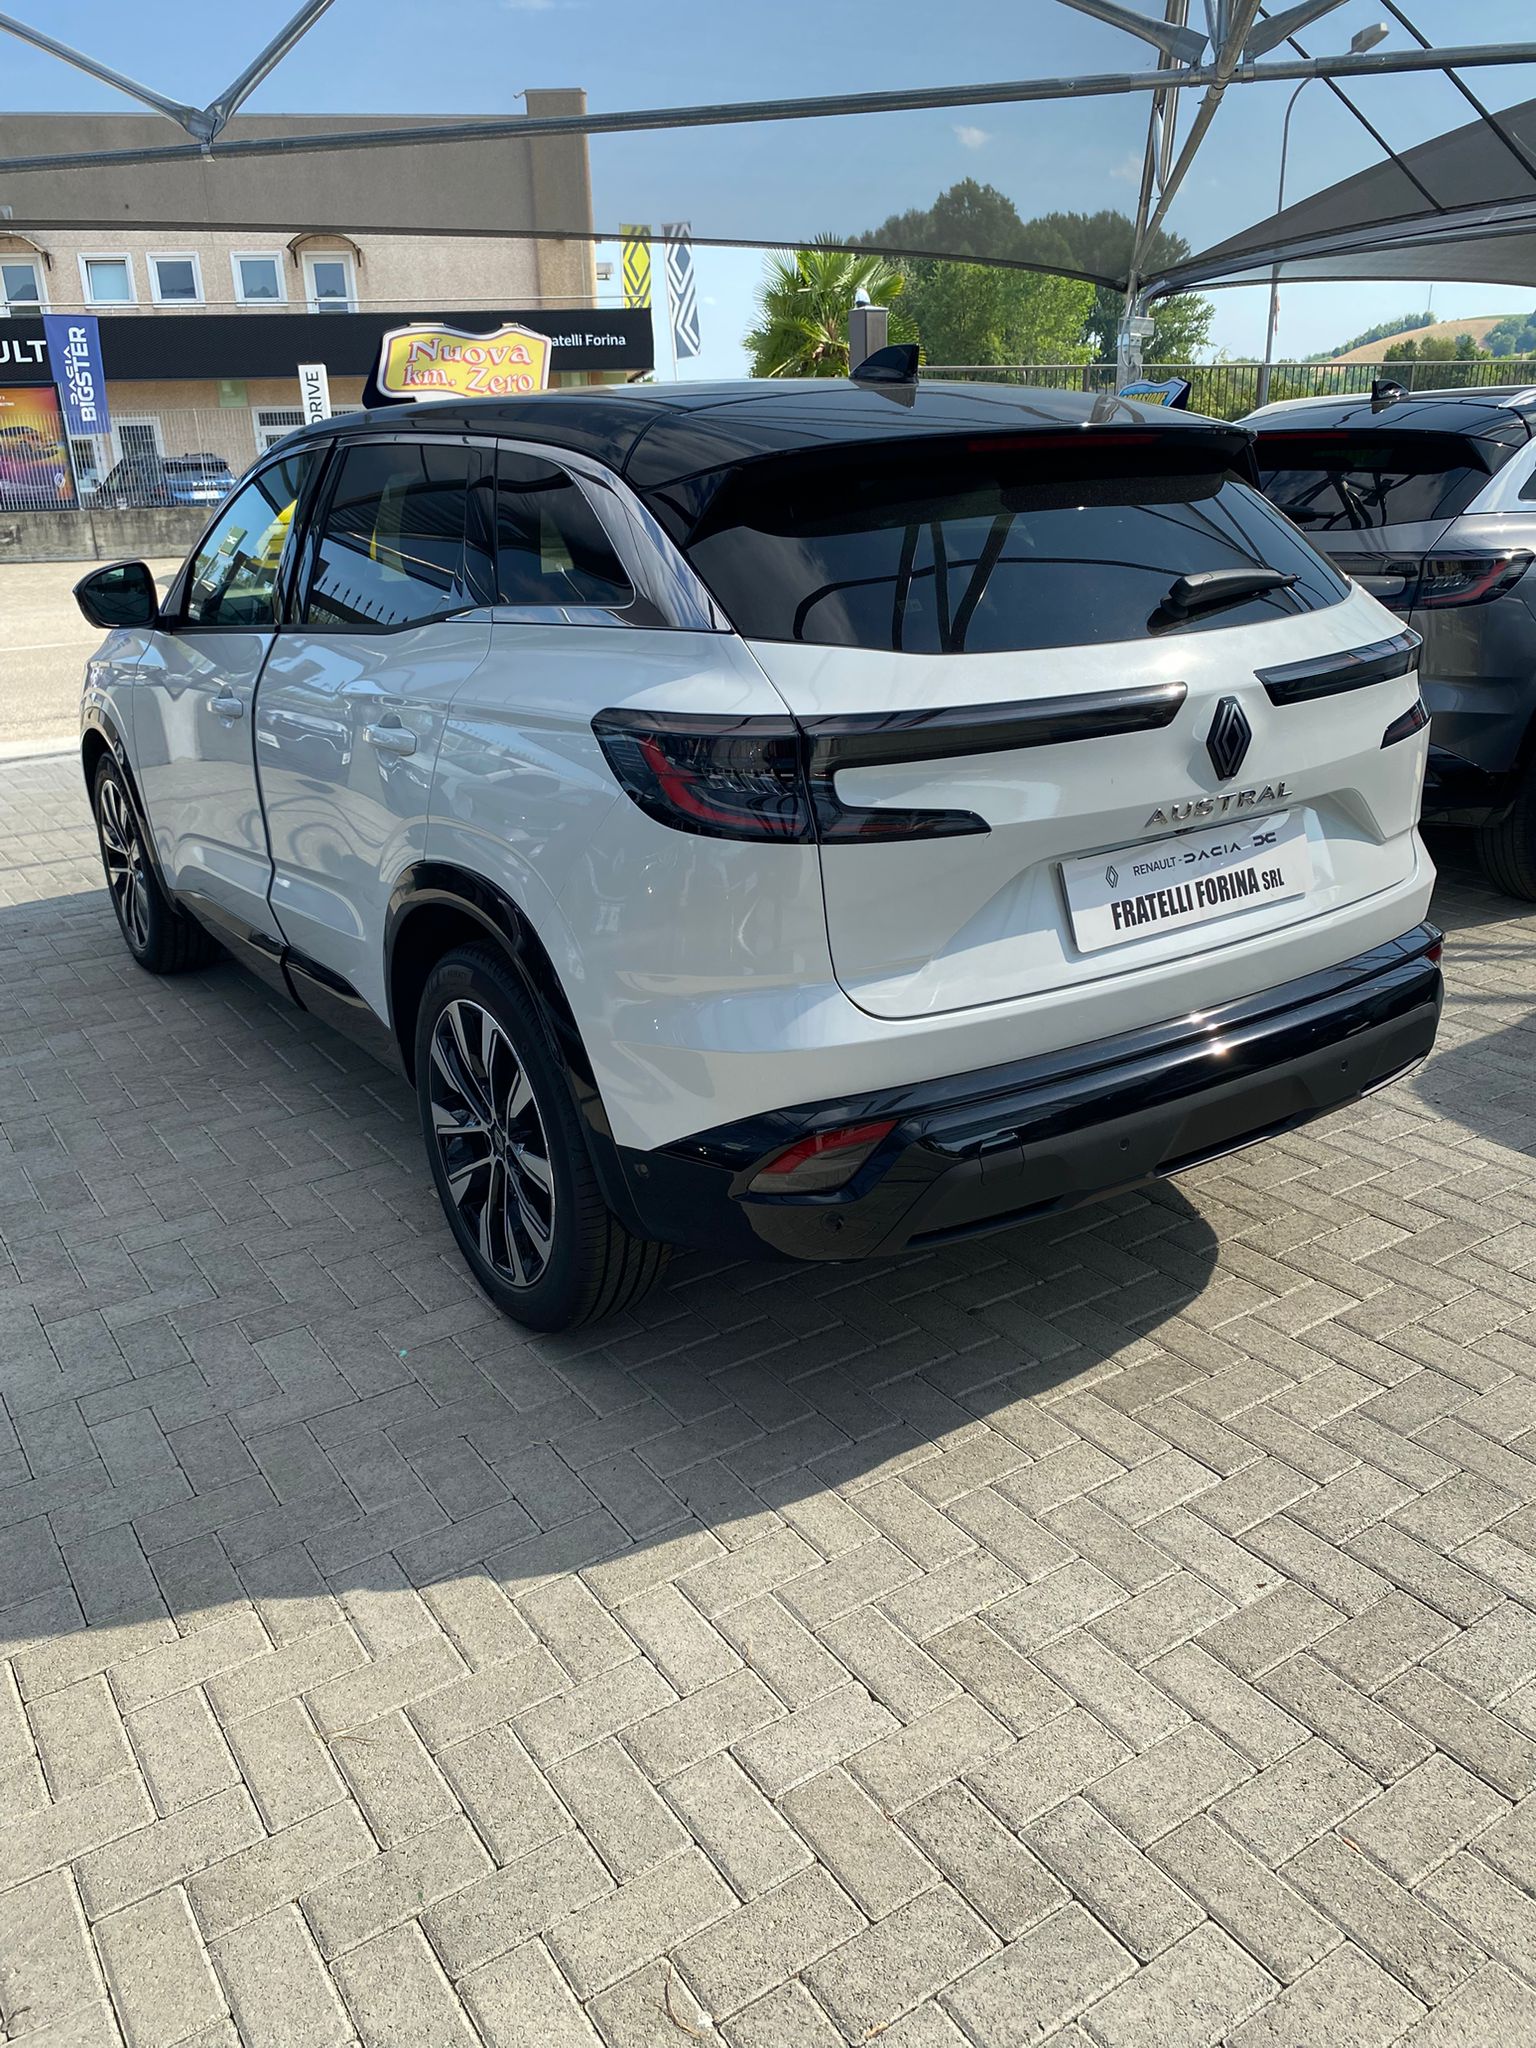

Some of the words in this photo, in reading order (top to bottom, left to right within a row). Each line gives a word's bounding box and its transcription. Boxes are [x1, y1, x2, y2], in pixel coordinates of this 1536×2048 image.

[406, 338, 532, 366] Nuova
[551, 333, 582, 347] atelli
[585, 333, 627, 346] Forina
[68, 326, 97, 422] BIGSTER
[402, 364, 456, 386] km.
[465, 367, 533, 395] Zero
[1144, 781, 1293, 829] AUSTRAL
[1133, 856, 1177, 877] RENAULT
[1183, 842, 1242, 864] DACIA
[1111, 884, 1194, 930] FRATELLI
[1195, 867, 1260, 908] FORINA
[1261, 868, 1285, 890] SRL
